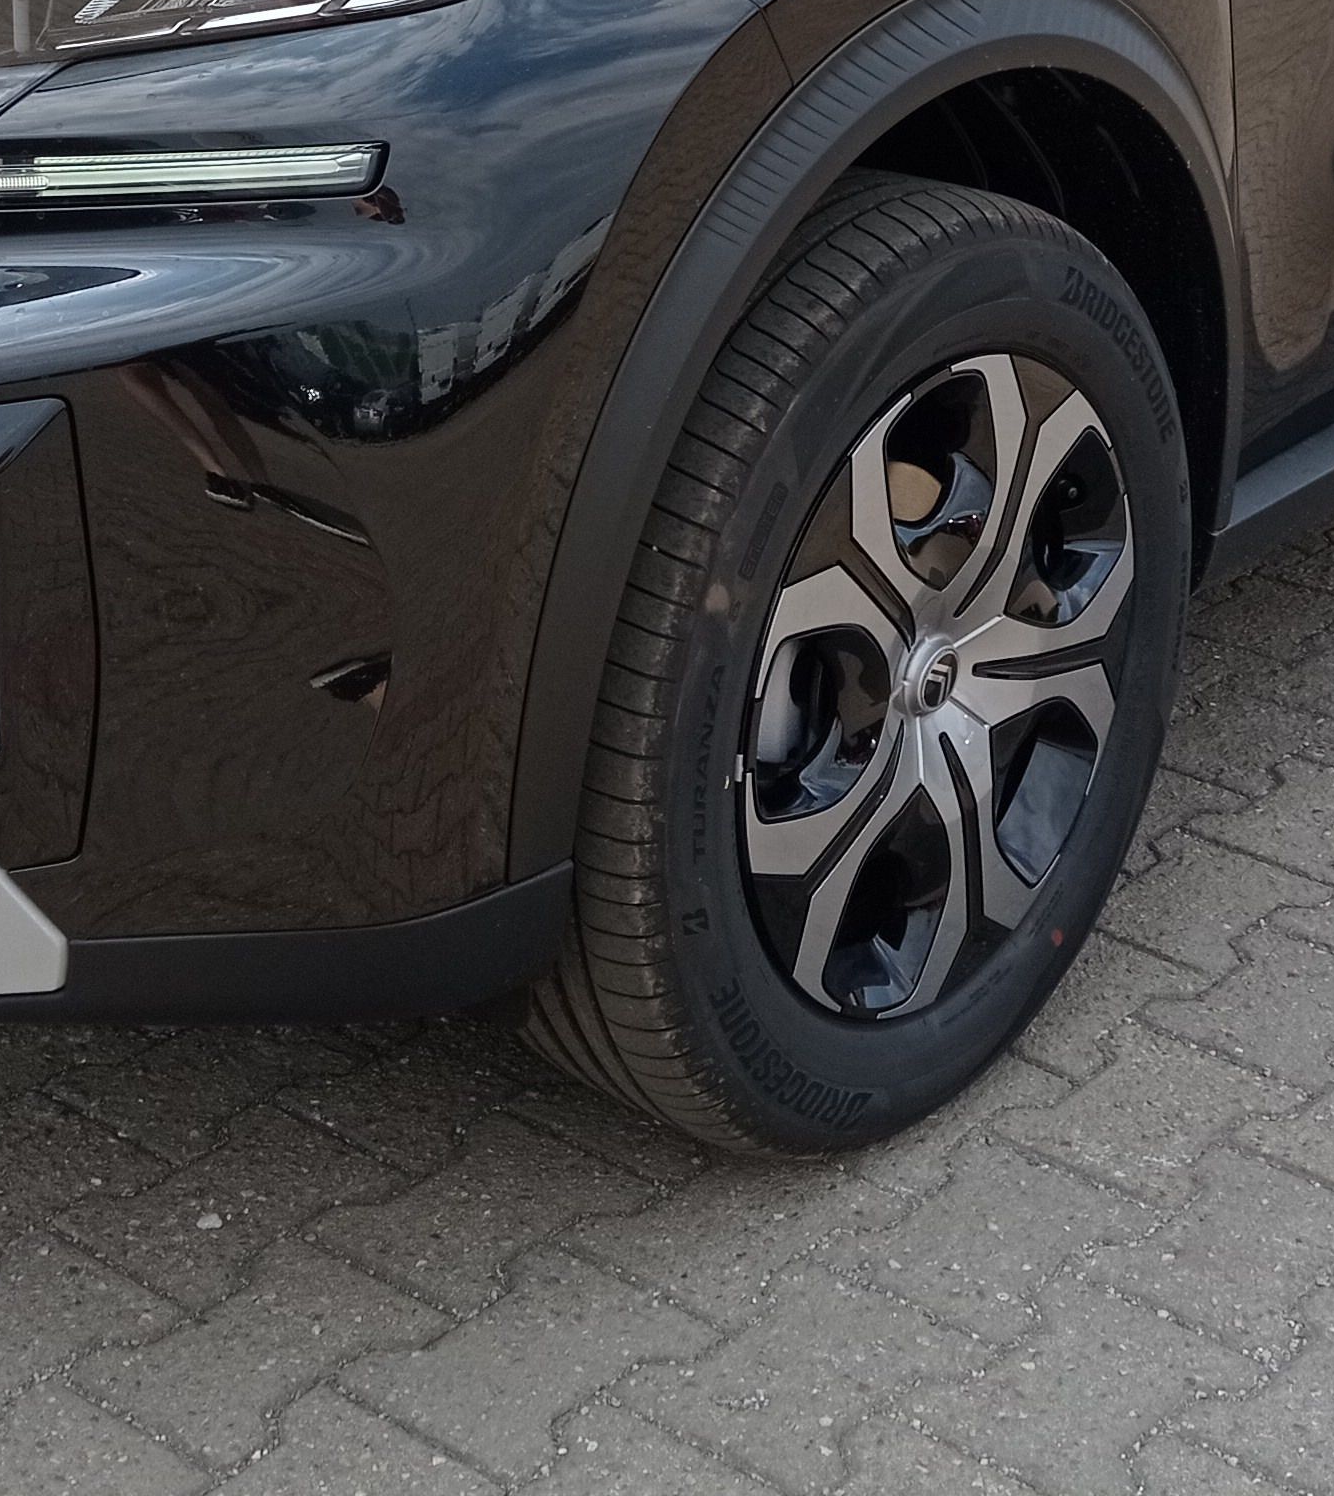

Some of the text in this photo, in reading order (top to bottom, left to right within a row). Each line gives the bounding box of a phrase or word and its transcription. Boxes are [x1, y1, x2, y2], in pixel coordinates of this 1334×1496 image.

[1058, 264, 1177, 445] BRIDGESTONE
[691, 664, 726, 866] TURANZA
[707, 977, 874, 1132] BRIDGESTONE
